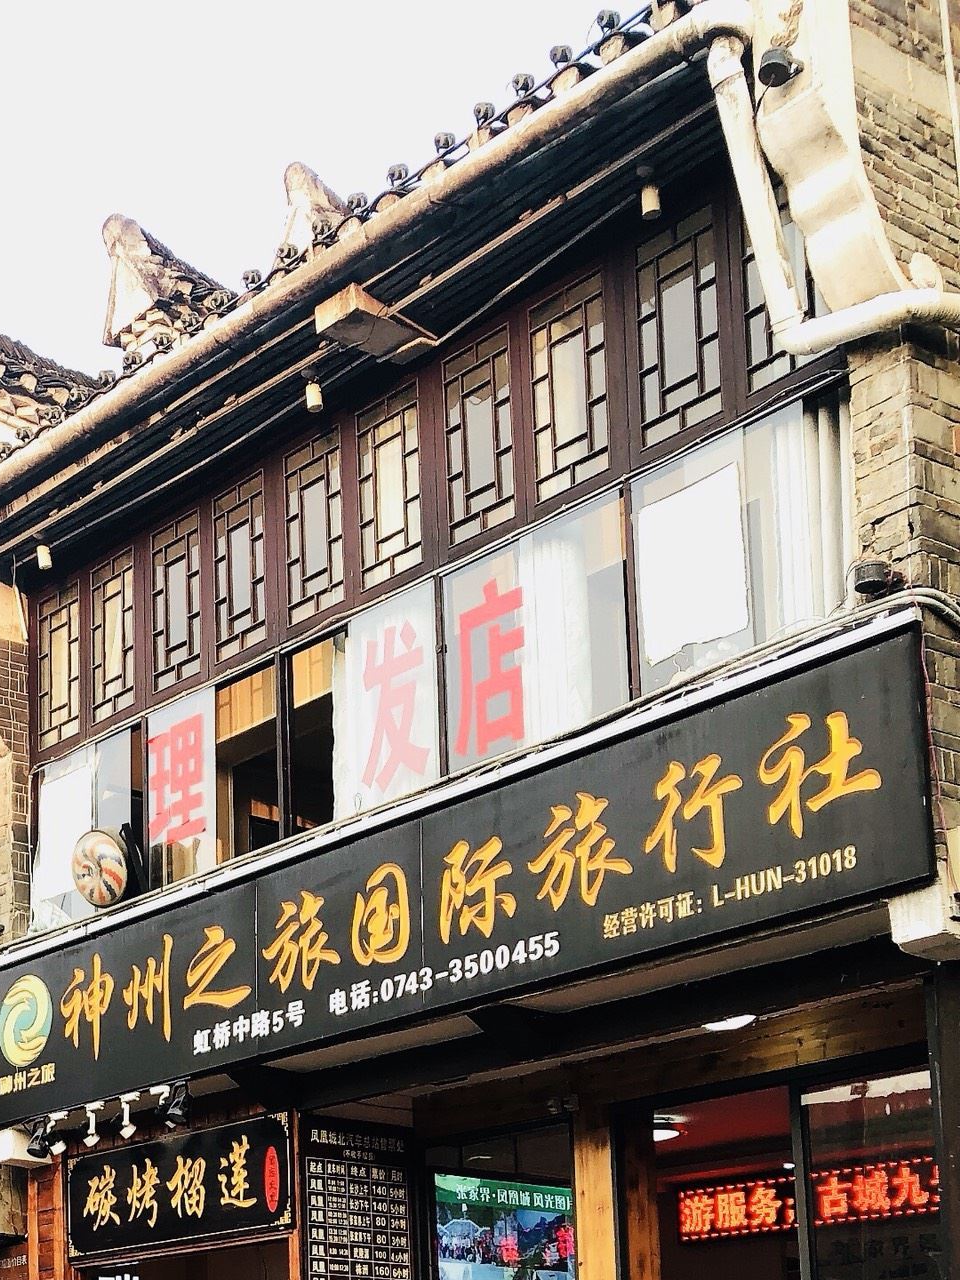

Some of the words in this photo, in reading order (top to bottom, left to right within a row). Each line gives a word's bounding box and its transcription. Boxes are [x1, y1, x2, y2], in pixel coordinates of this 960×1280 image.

[60, 711, 882, 1060] 神州之旅国际旅行社
[192, 1000, 306, 1056] 虹桥中路5号
[328, 931, 561, 1016] 电话:0743-3500455
[82, 1134, 258, 1232] 碳烤榴莲
[372, 1185, 387, 1195] 140
[390, 1187, 405, 1199] 5小时
[816, 1165, 940, 1218] 古城九
[372, 1201, 388, 1212] 140
[390, 1204, 406, 1215] 5小时
[375, 1216, 386, 1226] 80
[390, 1218, 406, 1230] 3小时
[376, 1234, 387, 1244] 80
[391, 1236, 407, 1247] 3小时
[374, 1250, 387, 1260] 100
[374, 1266, 390, 1276] 160
[392, 1267, 409, 1279] 6小时
